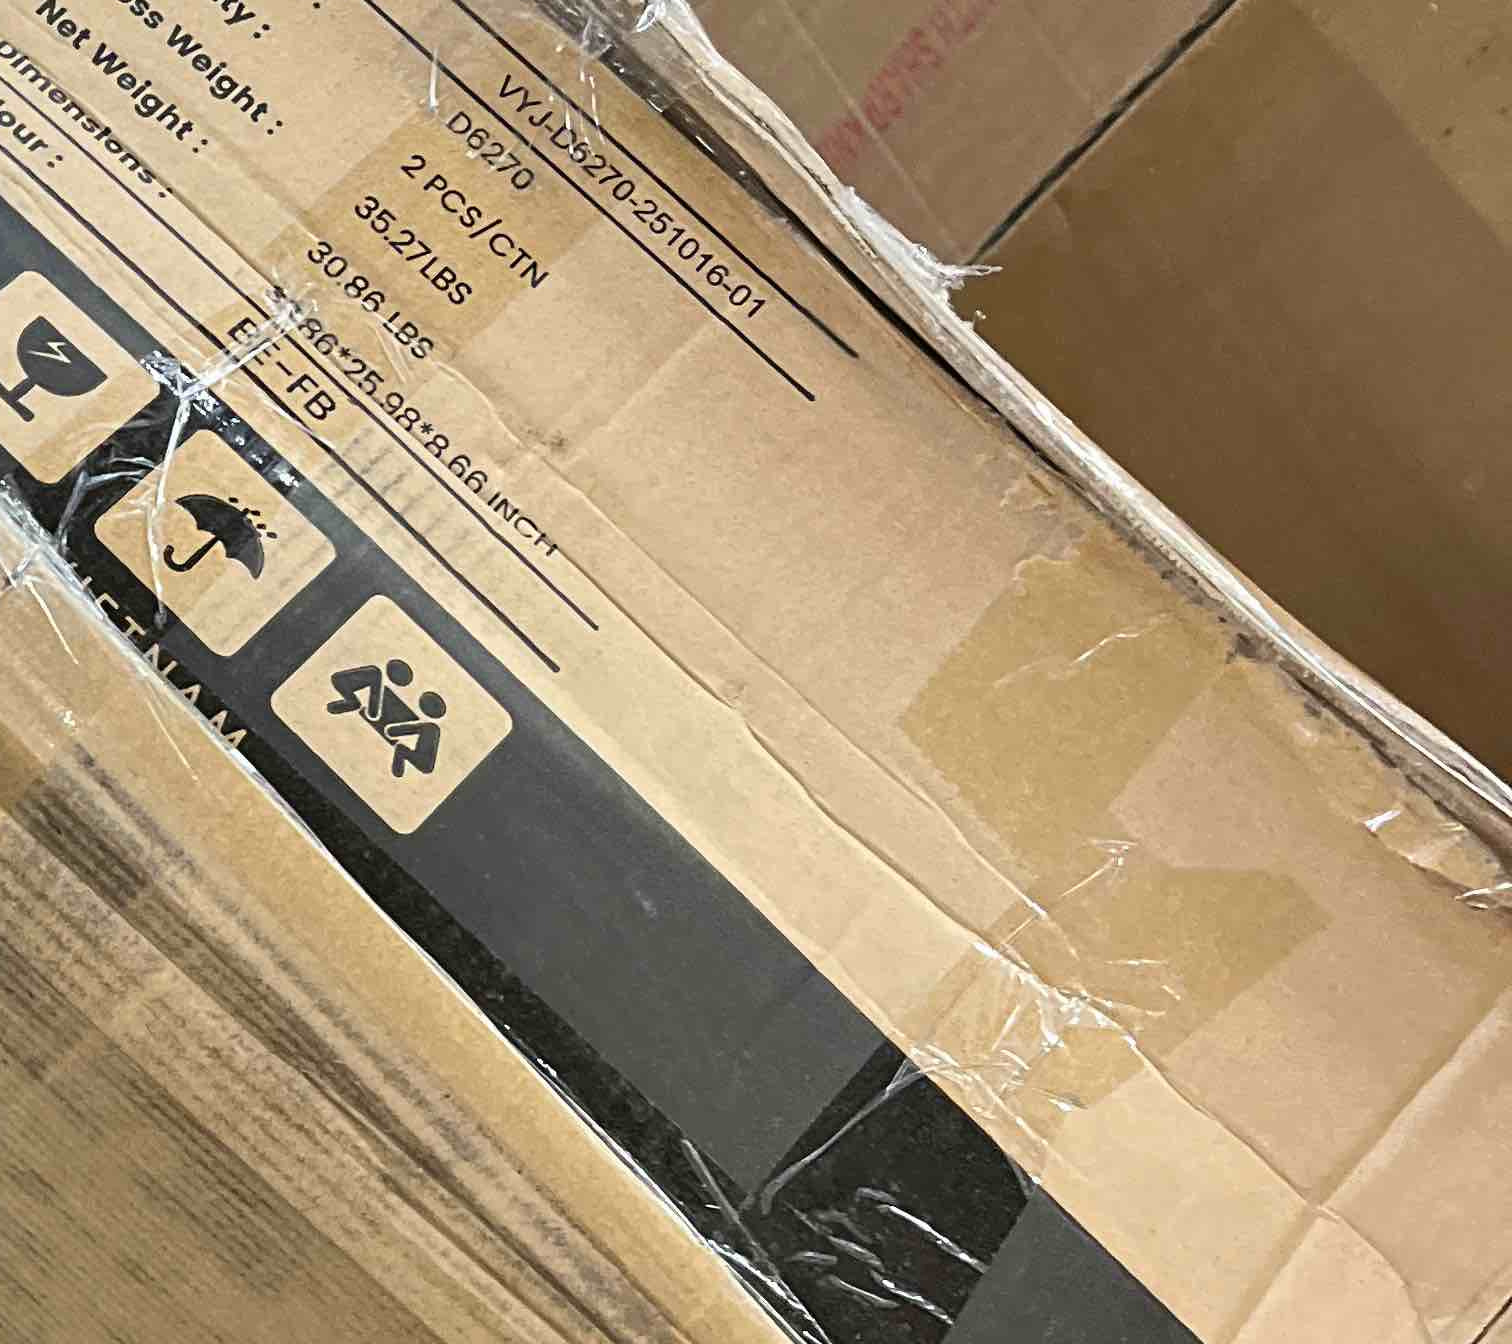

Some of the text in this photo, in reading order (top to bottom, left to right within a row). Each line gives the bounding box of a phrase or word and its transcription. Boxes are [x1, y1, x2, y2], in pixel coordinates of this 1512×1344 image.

[92, 43, 193, 141] Weight
[308, 242, 385, 312] 30.86
[383, 312, 434, 359] LBS
[167, 24, 267, 122] Weight
[355, 196, 472, 304] 35.27LBS
[401, 155, 426, 179] 2
[424, 174, 548, 288] PCS/CTN
[446, 112, 534, 189] D6270
[499, 74, 765, 317] VYJ-D6270-251016-01
[487, 492, 562, 556] INCH
